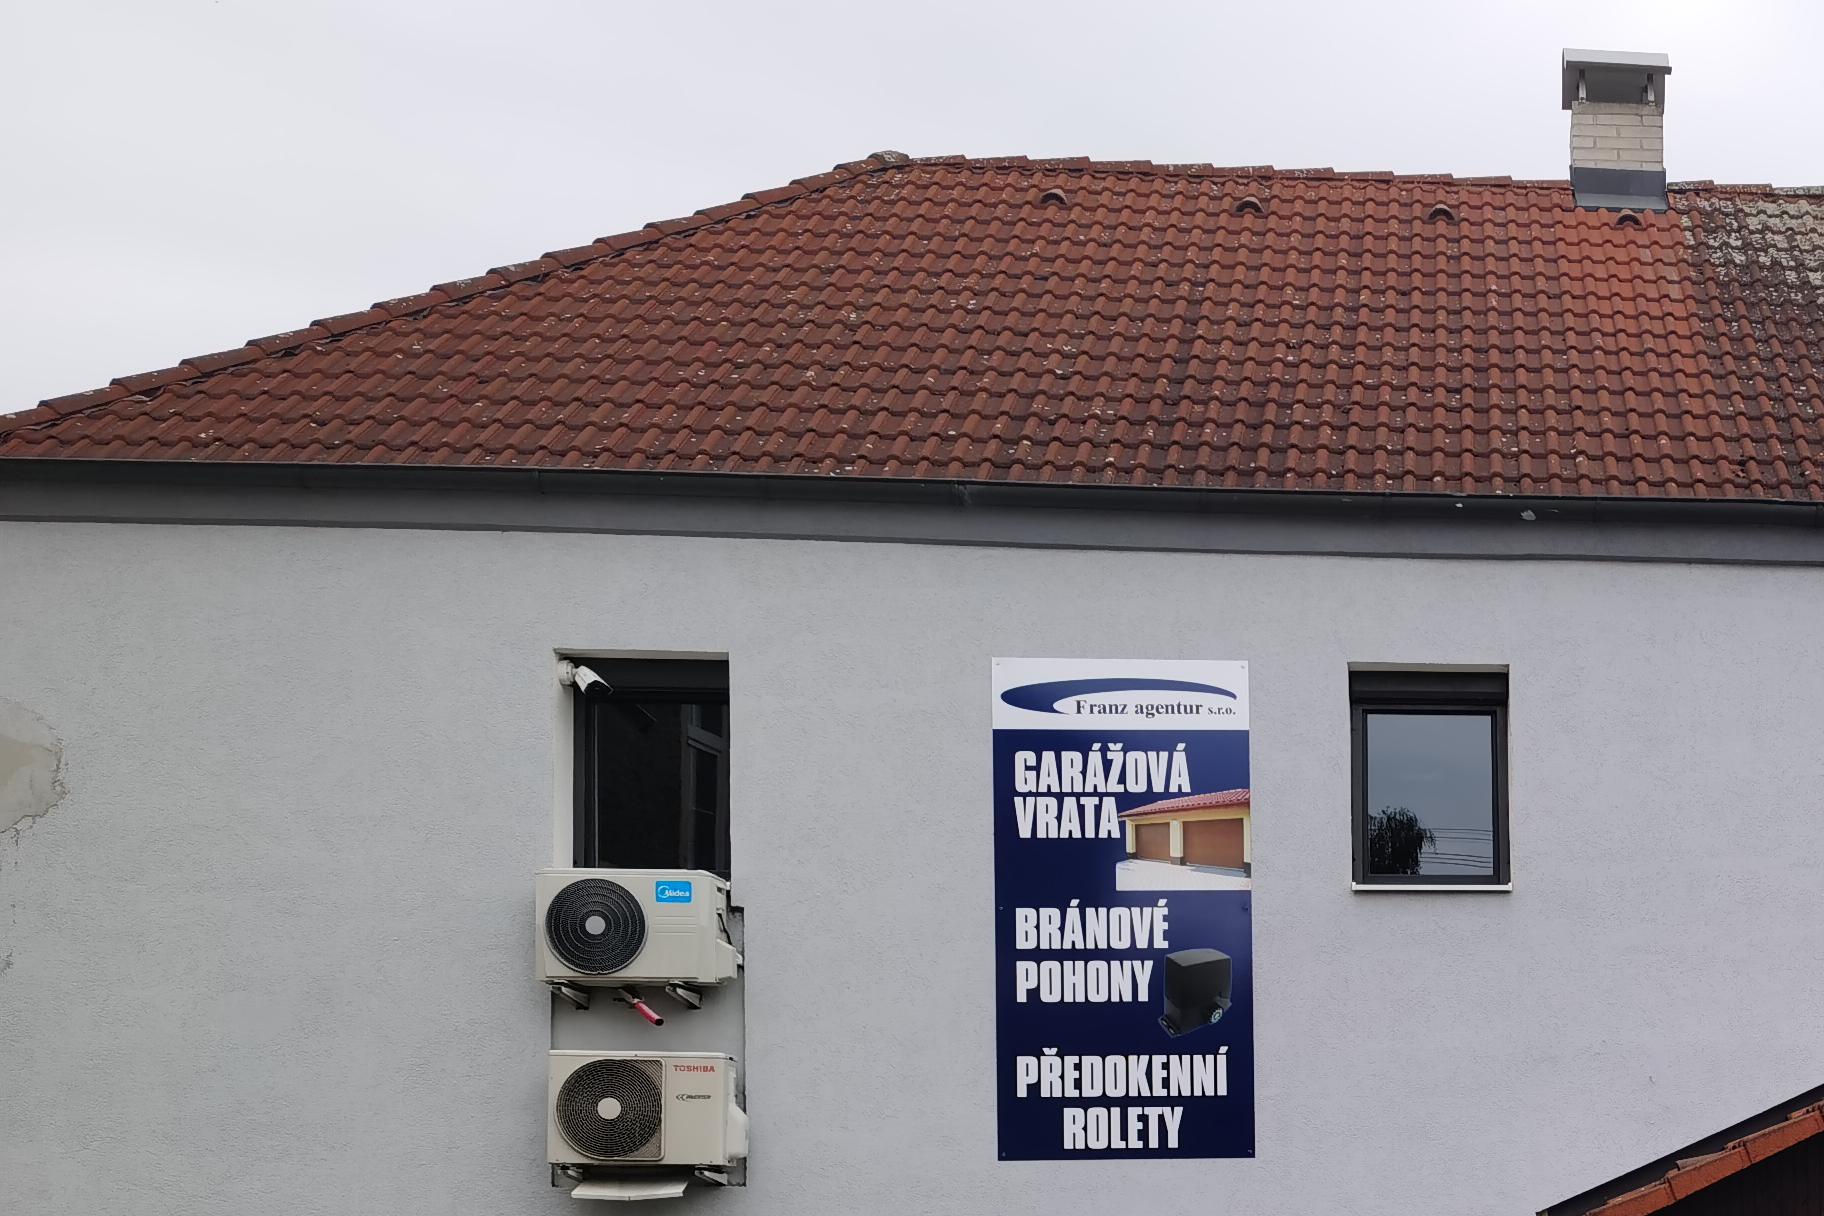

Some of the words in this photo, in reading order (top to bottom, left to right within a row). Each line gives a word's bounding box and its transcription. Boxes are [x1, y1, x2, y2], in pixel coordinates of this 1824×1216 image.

[1075, 699, 1128, 716] Franz
[1134, 702, 1203, 719] agentur
[1207, 705, 1236, 716] s.r.o.
[1014, 742, 1192, 793] GARÁŽOVÁ
[1014, 796, 1121, 839] VRATA
[1015, 898, 1169, 950] BRÁNOVÉ
[1016, 960, 1154, 1003] POHONY
[672, 1064, 716, 1073] TOSHIBA
[1016, 1045, 1229, 1098] PŘEDOKENNÍ
[1063, 1106, 1184, 1150] ROLETY
